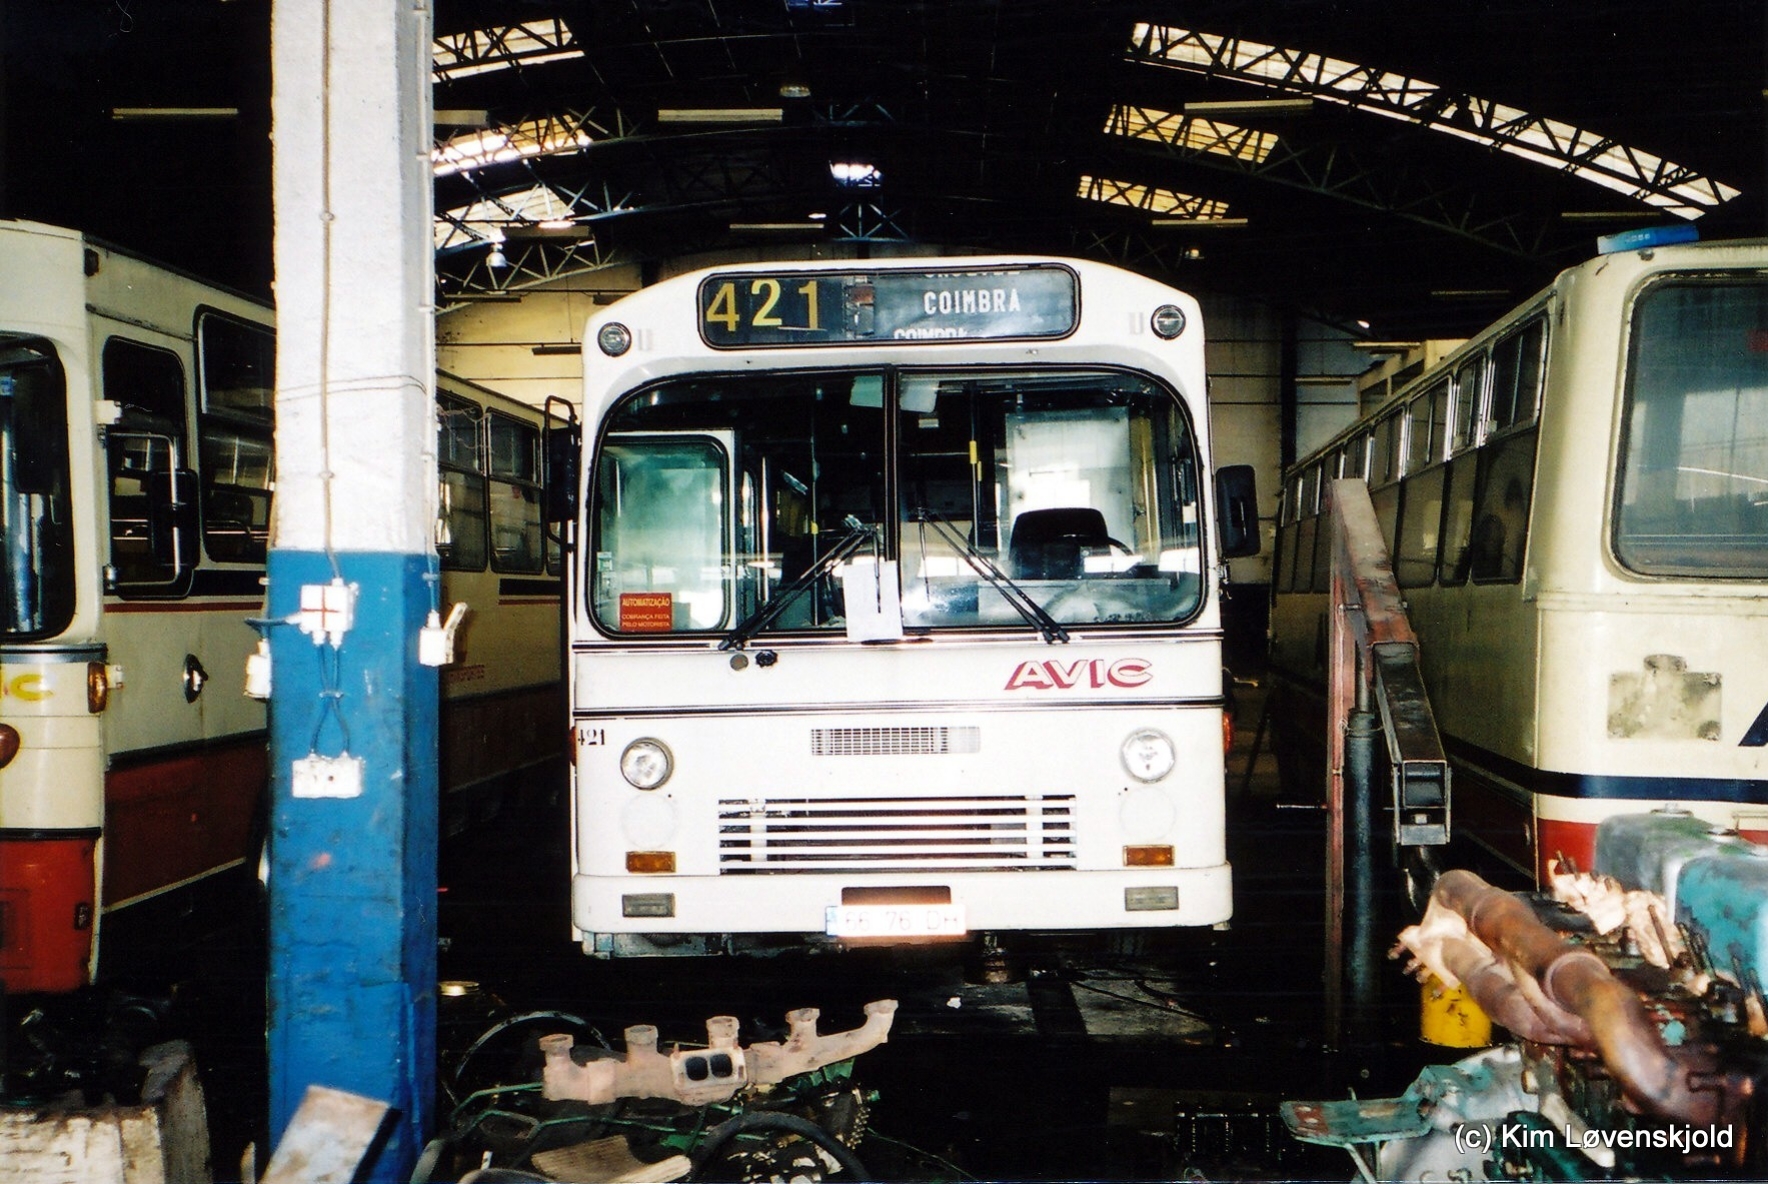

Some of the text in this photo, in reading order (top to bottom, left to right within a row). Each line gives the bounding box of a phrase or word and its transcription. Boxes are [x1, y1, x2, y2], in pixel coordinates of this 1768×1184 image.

[706, 279, 819, 332] 421
[923, 289, 1021, 315] COIMBRA
[622, 597, 670, 608] AUTOMATIZAÇÃO
[1004, 658, 1153, 690] AVIC
[577, 729, 605, 745] 421
